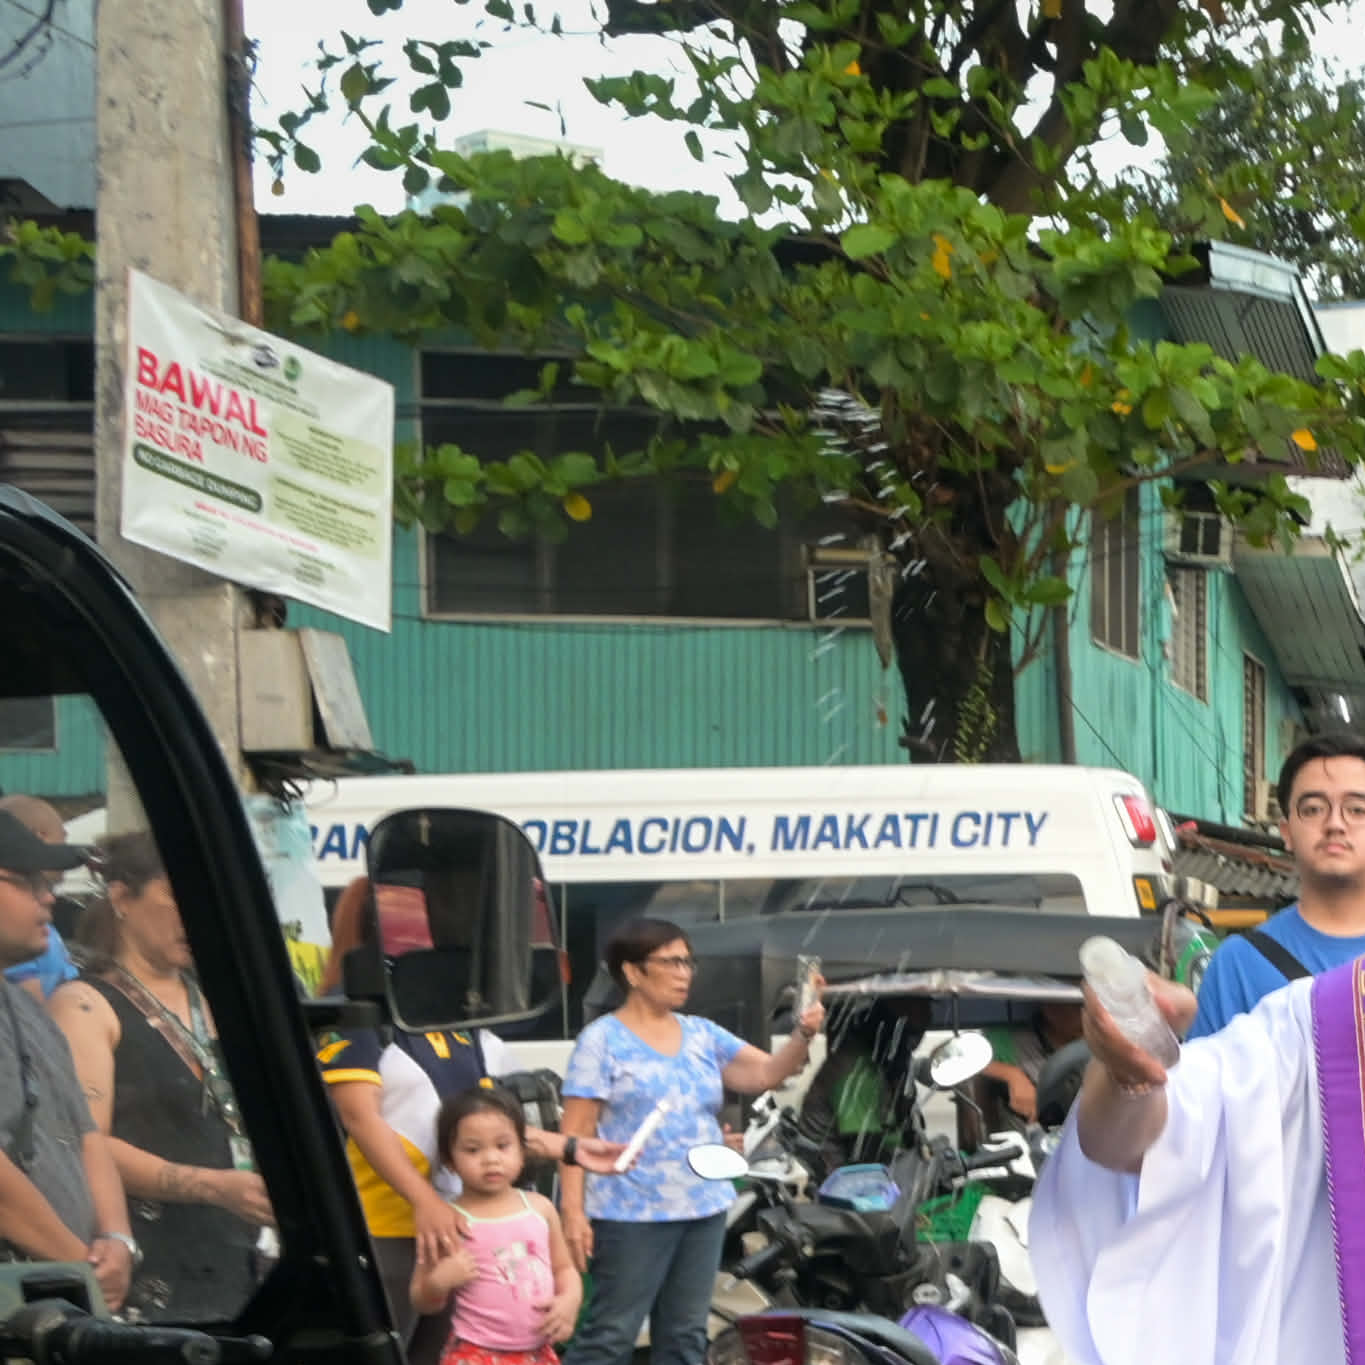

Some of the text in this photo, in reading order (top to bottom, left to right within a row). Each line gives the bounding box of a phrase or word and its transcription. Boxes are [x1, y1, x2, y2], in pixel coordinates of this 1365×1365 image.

[137, 345, 267, 438] BAWAL
[136, 388, 175, 425] MAG
[177, 406, 239, 452] TAPON
[242, 433, 269, 464] NG
[136, 413, 204, 464] BASURA
[522, 811, 1048, 855] OBLACION, MAKATI CITY
